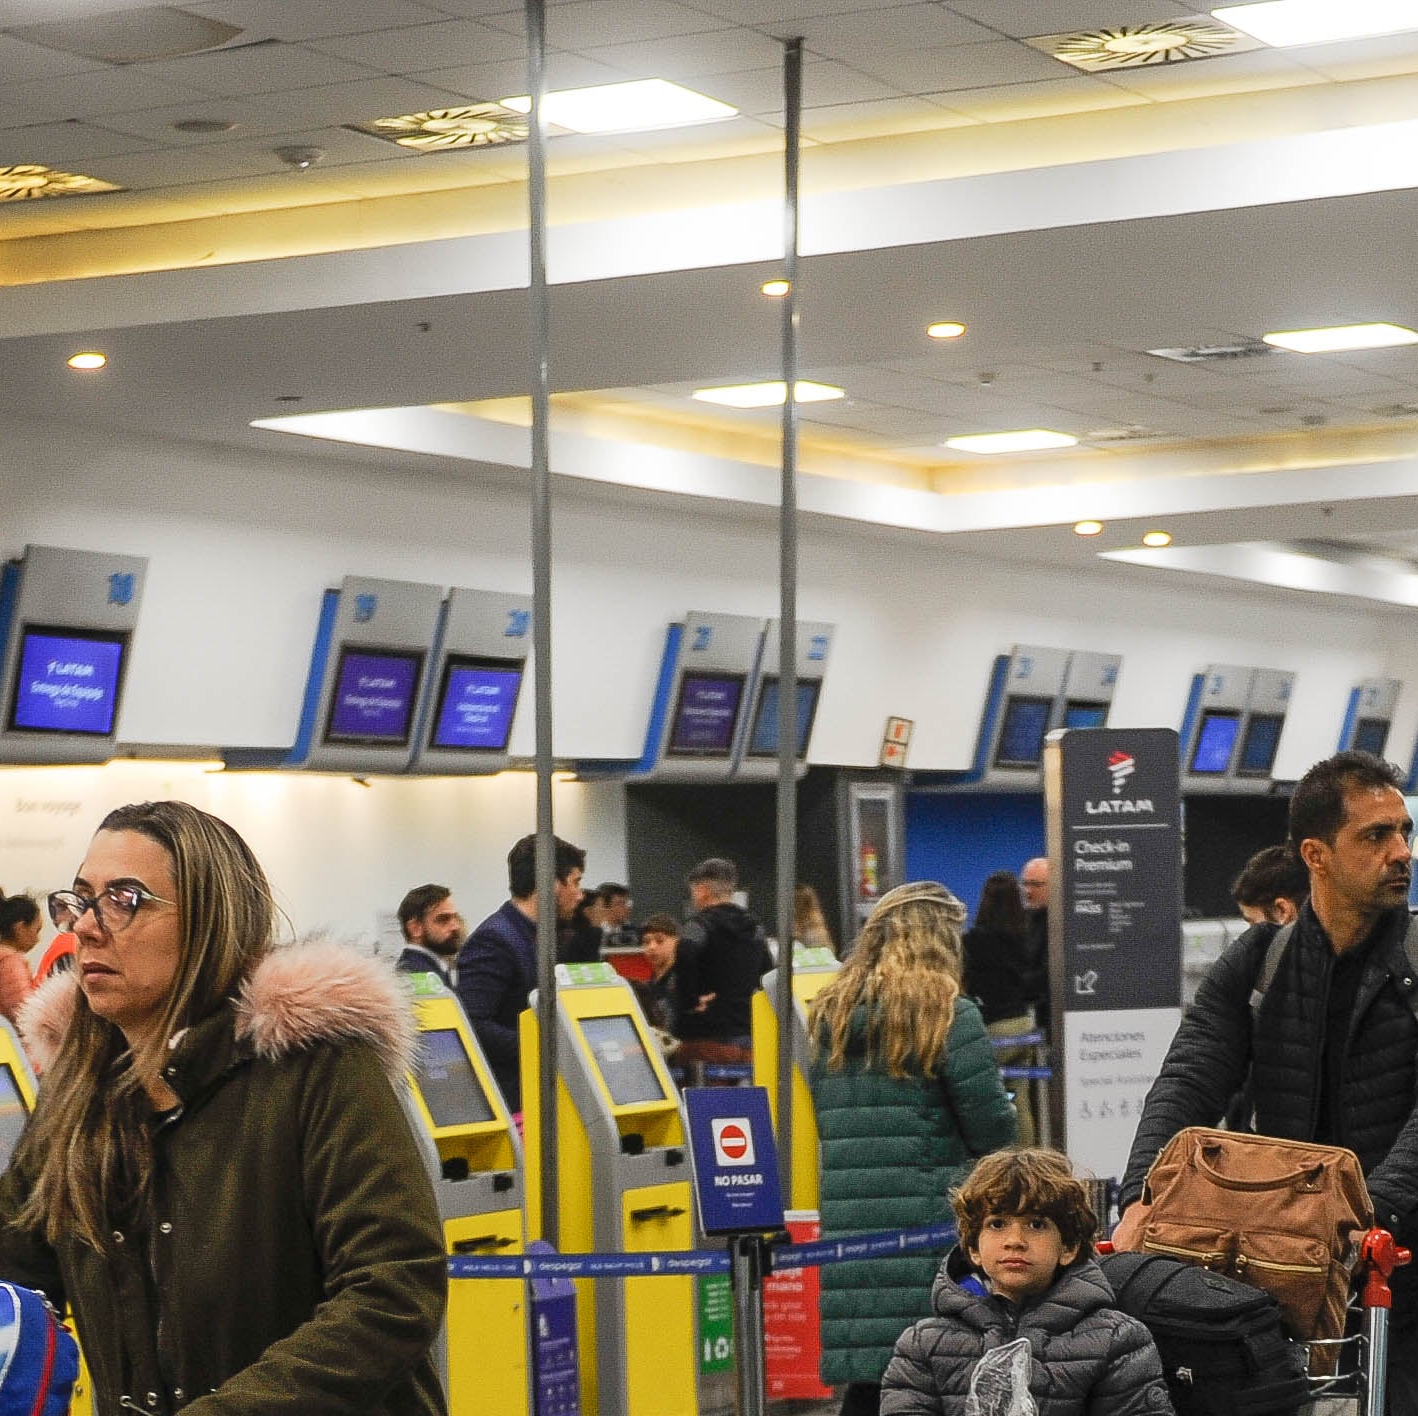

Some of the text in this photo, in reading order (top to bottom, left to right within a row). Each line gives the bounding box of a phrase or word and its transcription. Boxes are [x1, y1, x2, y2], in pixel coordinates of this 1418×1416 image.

[1085, 799, 1154, 814] LATAM
[1074, 839, 1131, 854] Check-in
[1075, 858, 1133, 872] Premium
[714, 1173, 764, 1187] NO PASAR
[539, 1262, 583, 1276] despegar
